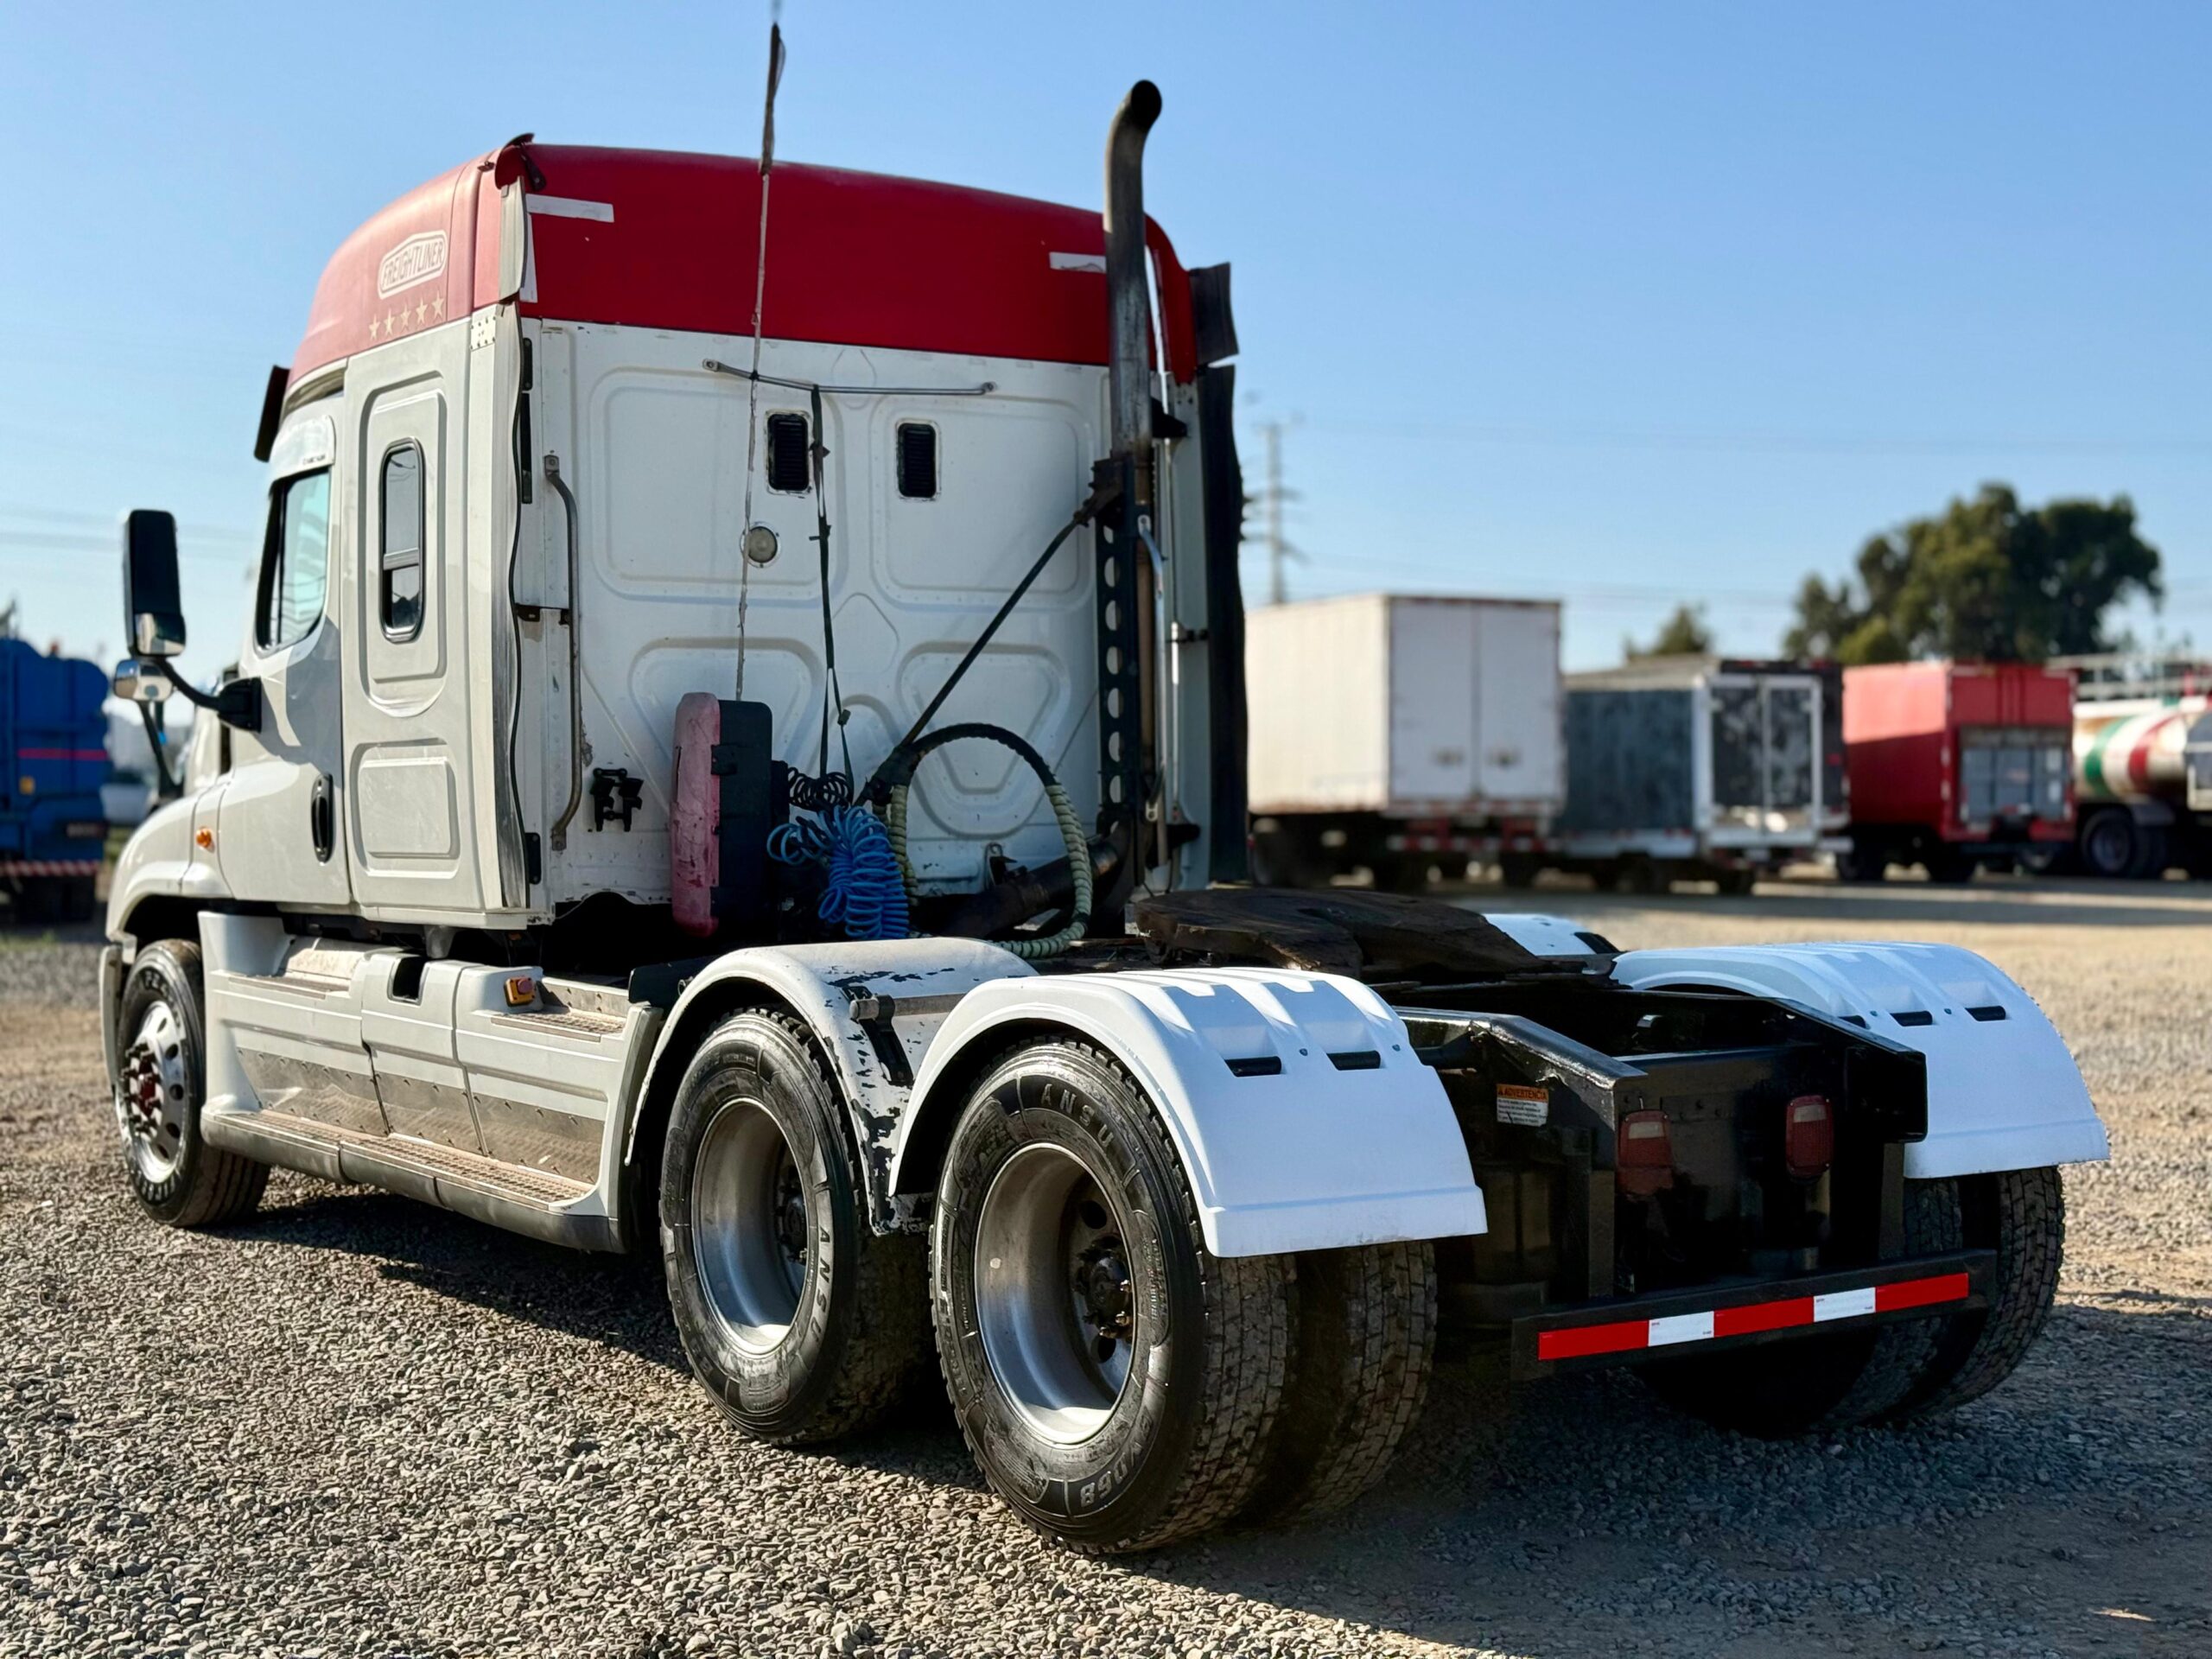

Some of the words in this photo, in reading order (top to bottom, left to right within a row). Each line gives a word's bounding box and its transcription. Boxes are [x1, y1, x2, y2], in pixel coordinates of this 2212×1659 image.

[382, 240, 444, 288] FREIGHTLINER
[1040, 1083, 1115, 1147] ANSU
[810, 1225, 831, 1342] ANSU
